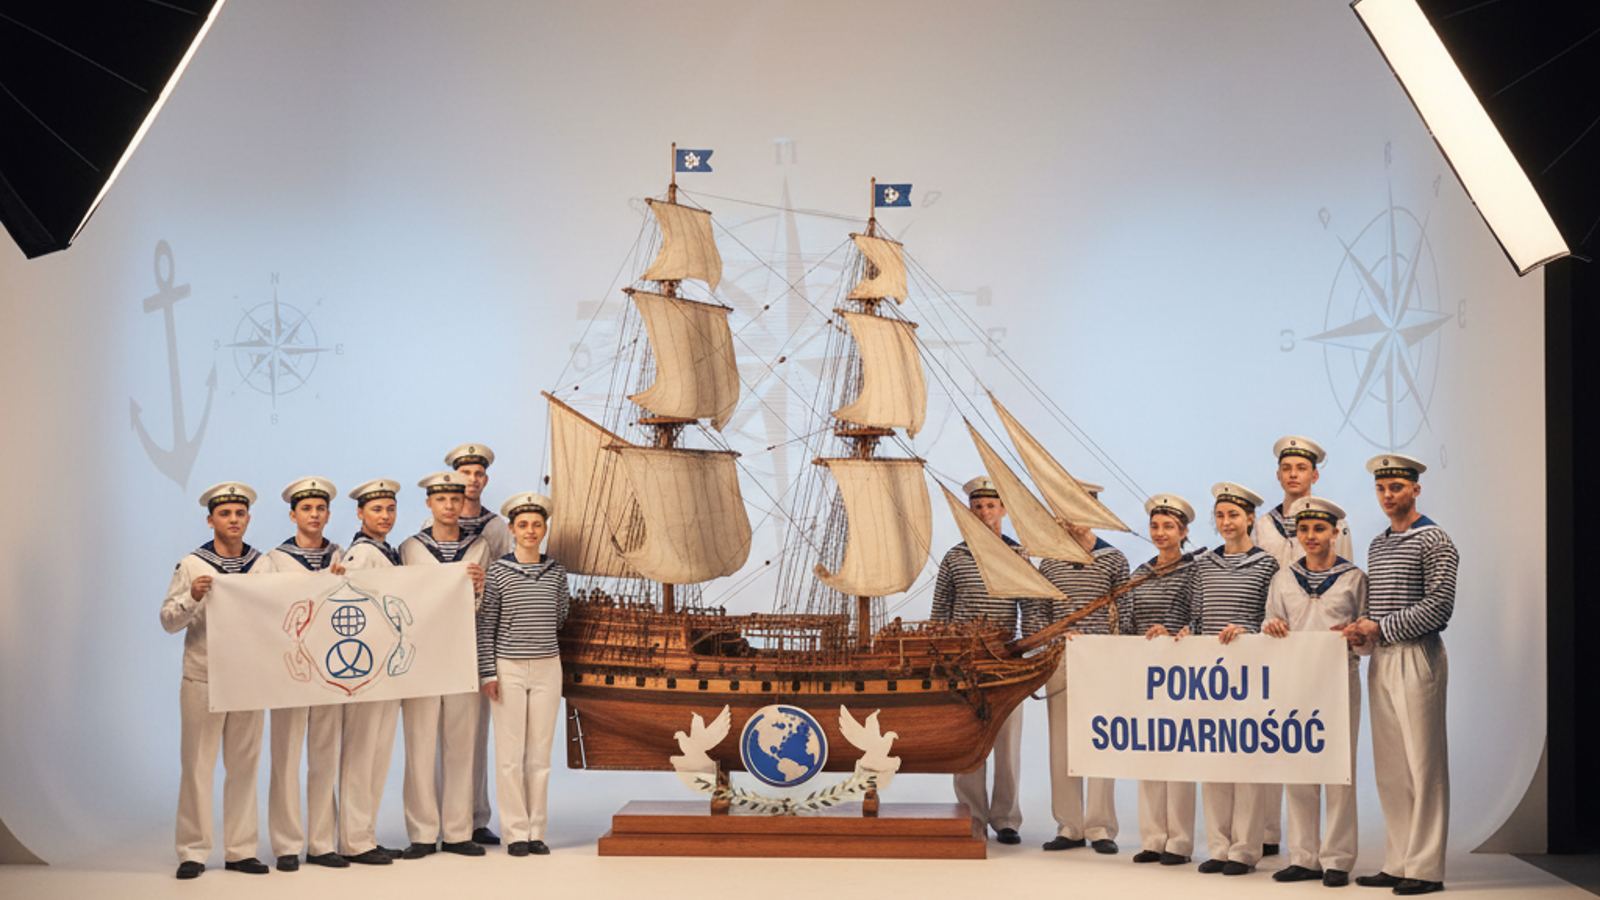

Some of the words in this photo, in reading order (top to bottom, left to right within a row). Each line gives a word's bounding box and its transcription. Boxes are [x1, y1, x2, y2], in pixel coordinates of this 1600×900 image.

[1146, 657, 1249, 701] POKÓJ
[1261, 665, 1270, 700] I
[1091, 708, 1326, 754] SOLIDARNOŚÓĆ
